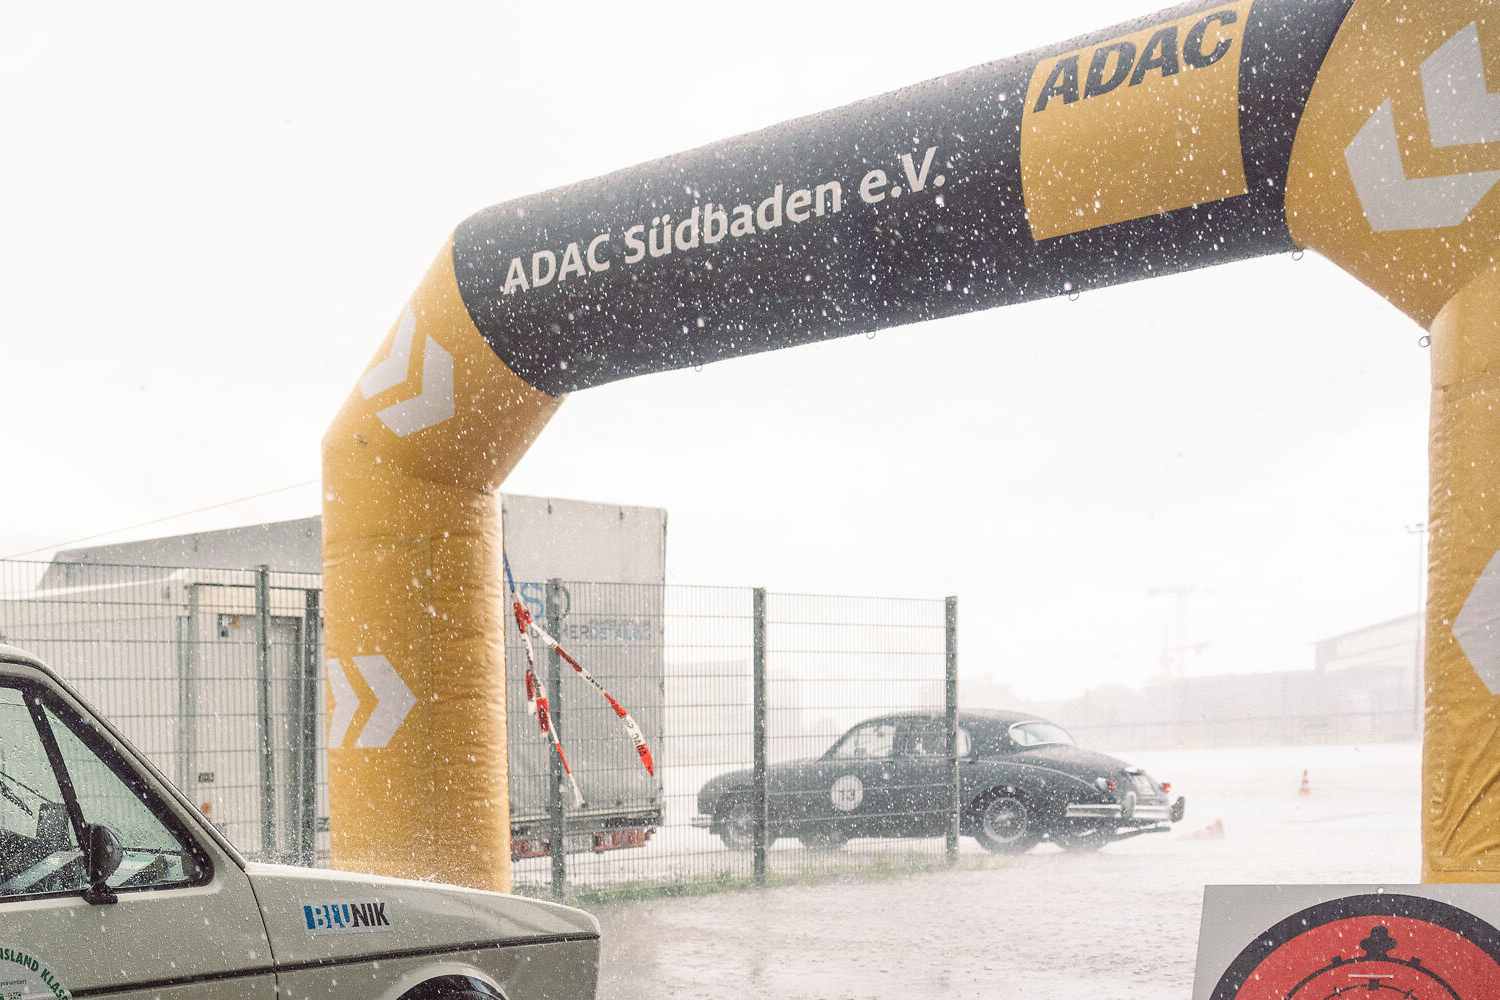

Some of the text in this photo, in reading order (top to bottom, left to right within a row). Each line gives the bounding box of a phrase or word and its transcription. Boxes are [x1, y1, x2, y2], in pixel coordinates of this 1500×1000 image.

[1032, 9, 1238, 114] ADAC
[502, 146, 946, 296] ADAC Südbaden e.V.
